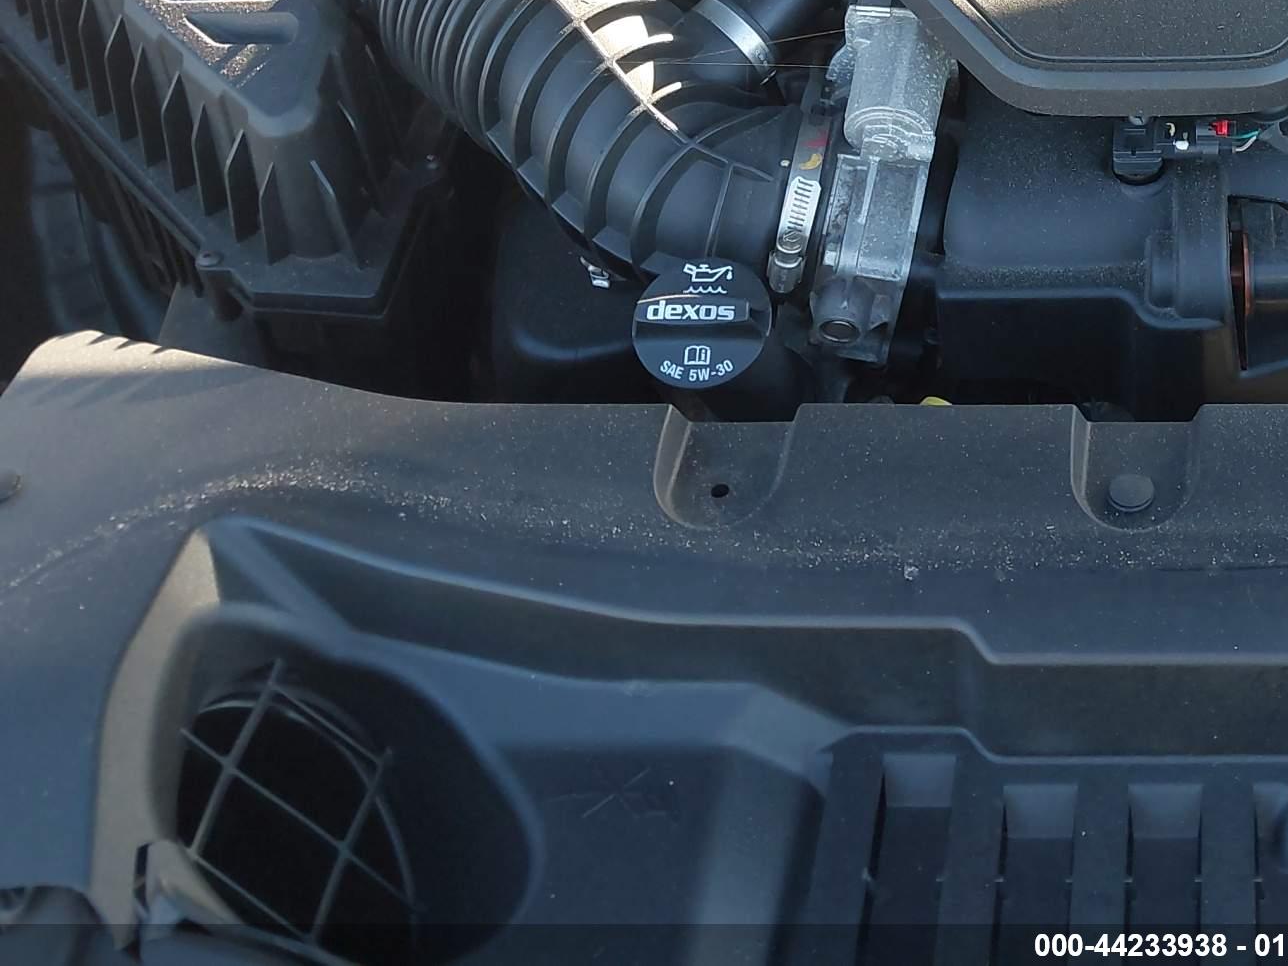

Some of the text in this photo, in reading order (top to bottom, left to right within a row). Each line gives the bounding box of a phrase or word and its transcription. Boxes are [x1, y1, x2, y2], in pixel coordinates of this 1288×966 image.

[646, 299, 736, 321] dexos
[659, 359, 734, 382] SAE 5W-30
